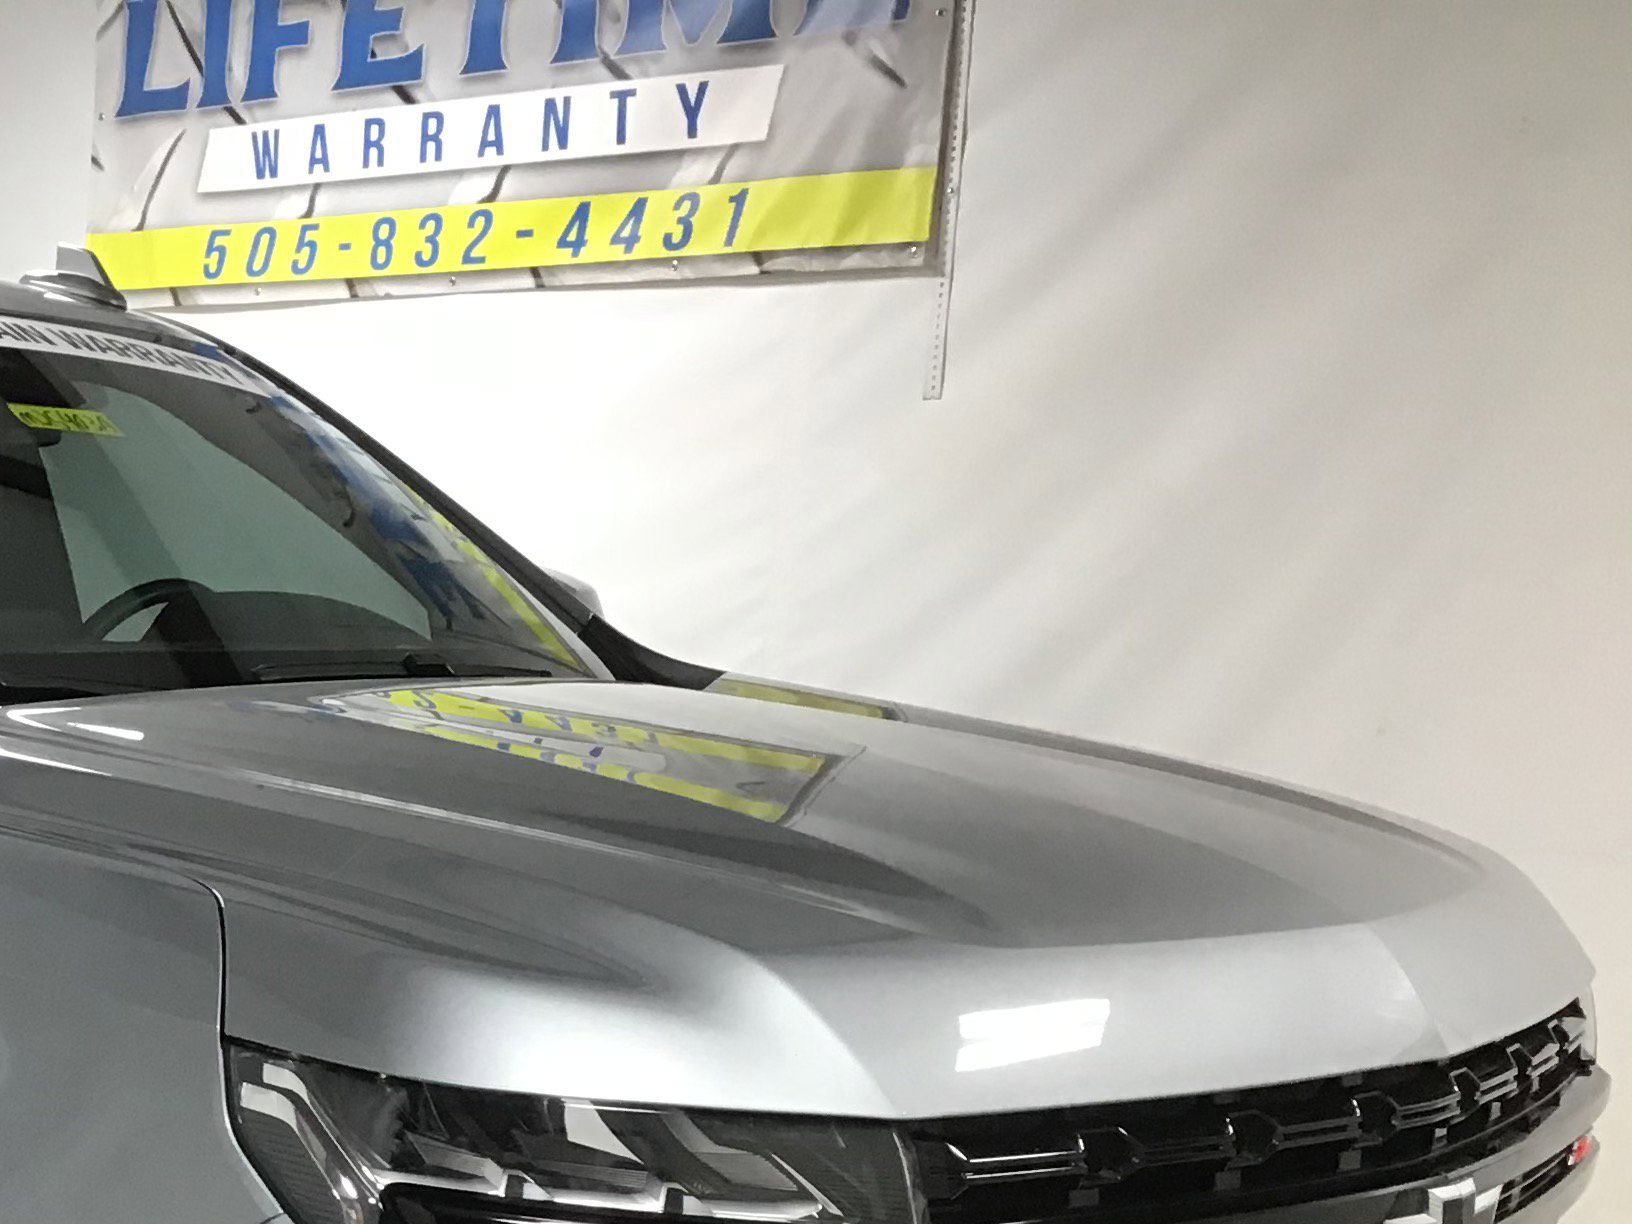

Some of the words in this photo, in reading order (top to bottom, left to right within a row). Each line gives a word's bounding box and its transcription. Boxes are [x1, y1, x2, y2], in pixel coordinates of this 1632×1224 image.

[114, 0, 908, 118] LIFE
[251, 80, 710, 181] WARRANTY
[203, 187, 750, 280] 505-832-4431
[49, 327, 244, 386] WARRANTY
